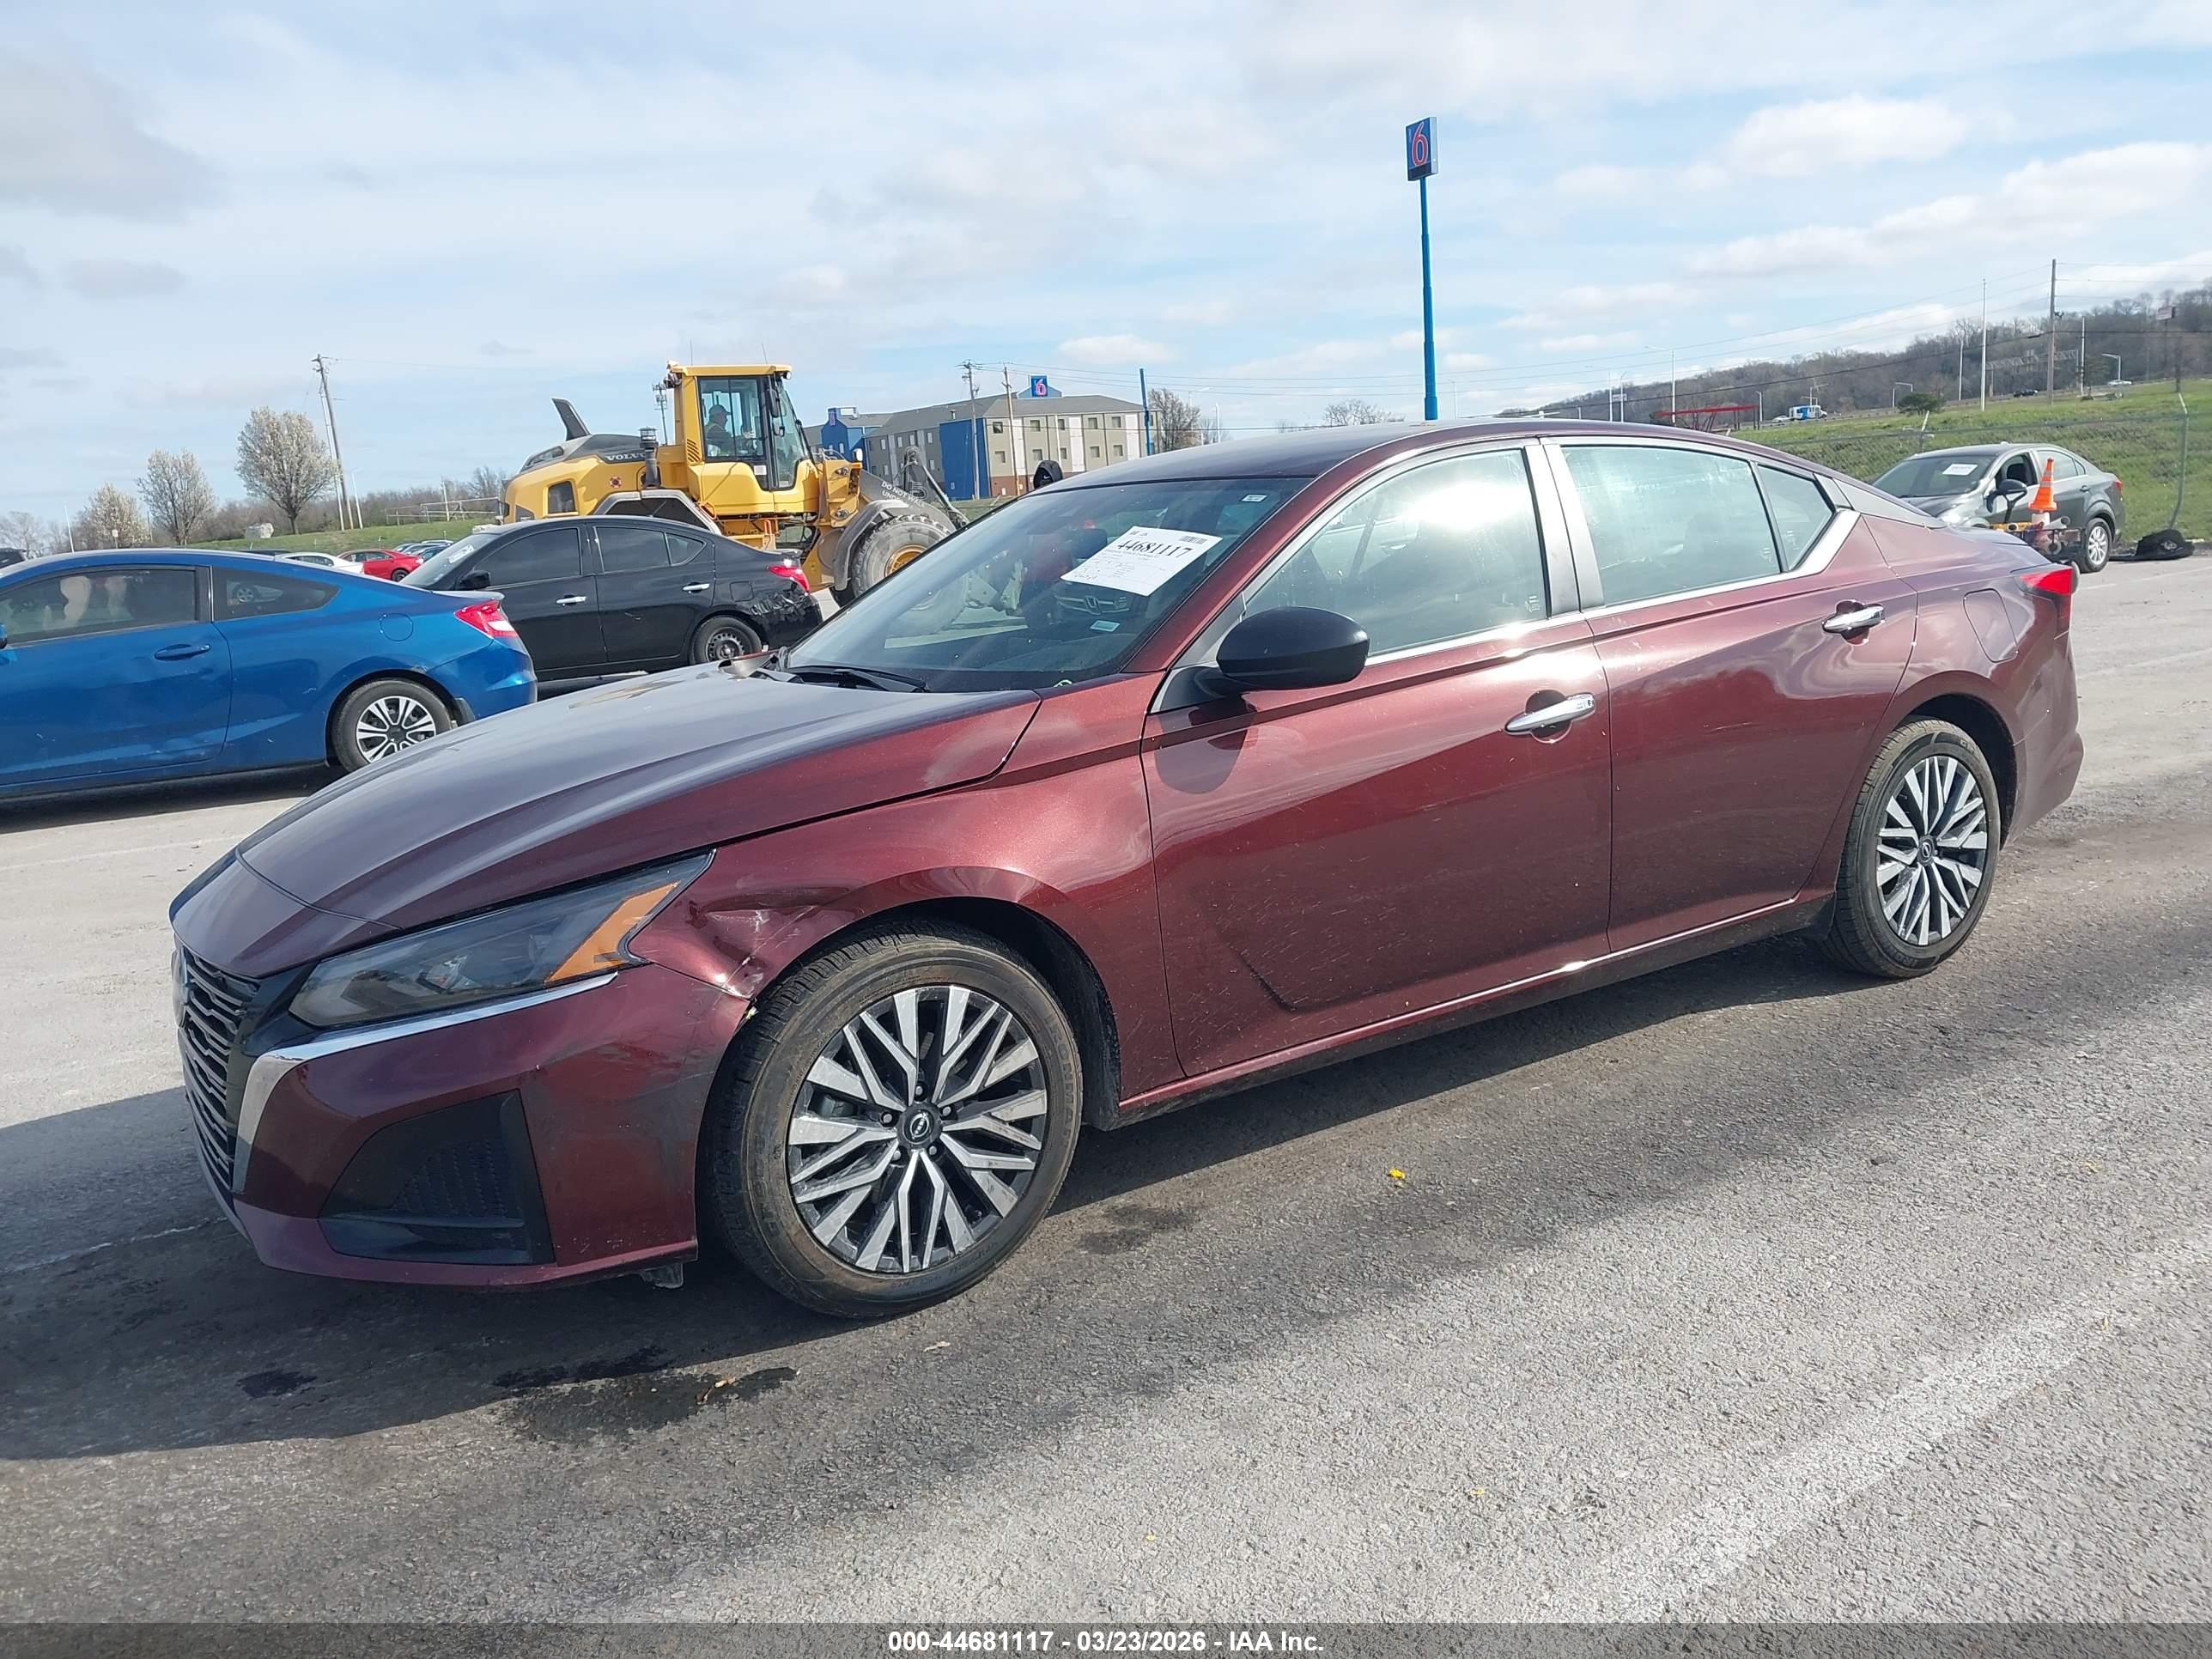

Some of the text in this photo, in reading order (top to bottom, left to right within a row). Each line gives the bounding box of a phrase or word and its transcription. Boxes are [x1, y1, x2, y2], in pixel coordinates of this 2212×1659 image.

[1412, 121, 1429, 166] 6
[1036, 379, 1047, 396] 6
[881, 481, 892, 490] DO
[893, 487, 907, 498] NOT
[1117, 539, 1194, 558] 44681117
